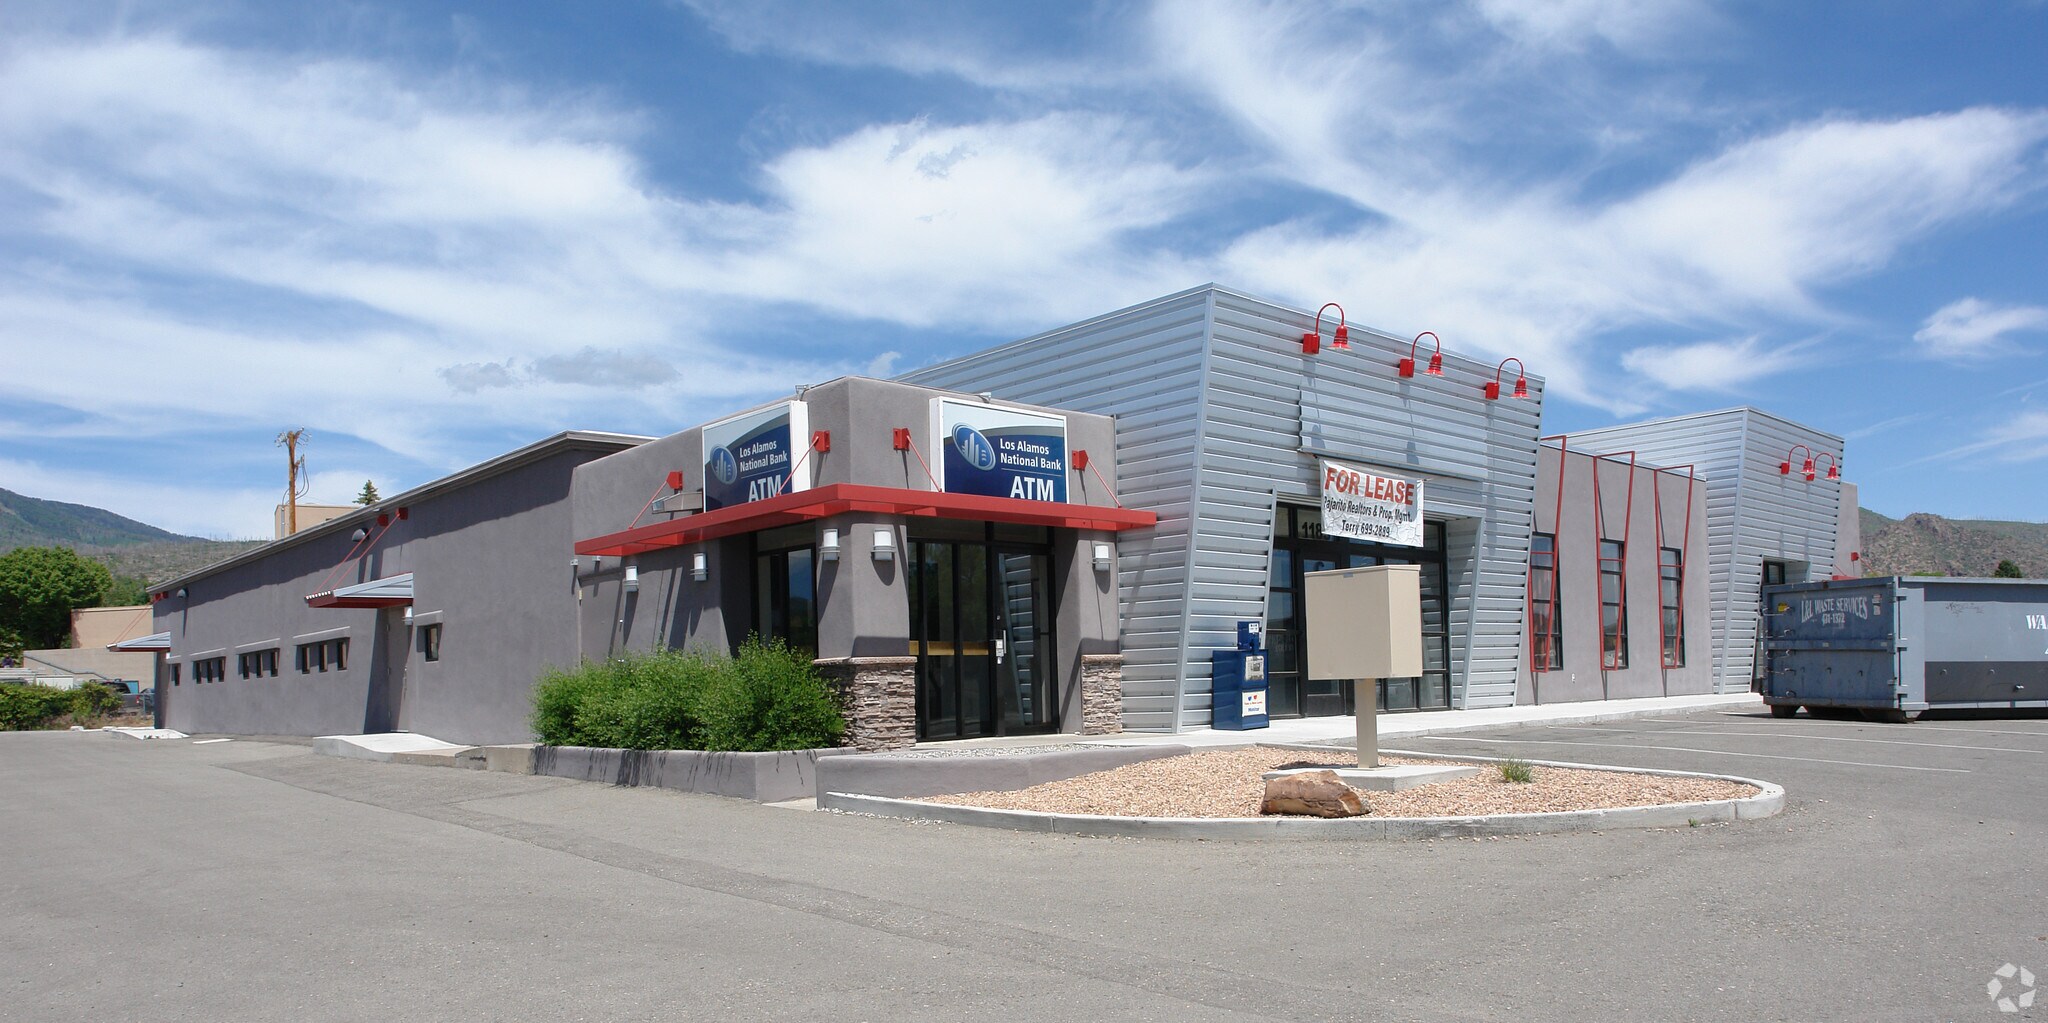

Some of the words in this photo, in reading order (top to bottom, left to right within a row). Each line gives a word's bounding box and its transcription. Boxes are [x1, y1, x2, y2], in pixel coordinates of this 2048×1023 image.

[739, 447, 751, 458] Los
[752, 440, 777, 455] Alamos
[1000, 438, 1015, 450] Los
[1017, 441, 1049, 455] Alamos
[740, 455, 768, 472] National
[770, 450, 787, 465] Bank
[1000, 453, 1038, 467] National
[1041, 458, 1061, 470] Bank
[748, 474, 782, 503] ATM
[1010, 476, 1054, 502] ATM
[1324, 467, 1360, 495] FOR
[1364, 475, 1415, 505] LEASE
[1324, 496, 1346, 512] Pajarito
[1347, 501, 1372, 517] Realtors
[1373, 505, 1378, 517] &
[1379, 506, 1394, 522] Prop.
[1395, 508, 1413, 524] Mgmt.
[1342, 520, 1359, 535] Terry
[1814, 598, 1835, 614] WASTE
[1836, 597, 1868, 620] SERVICES
[2025, 614, 2048, 630] WA
